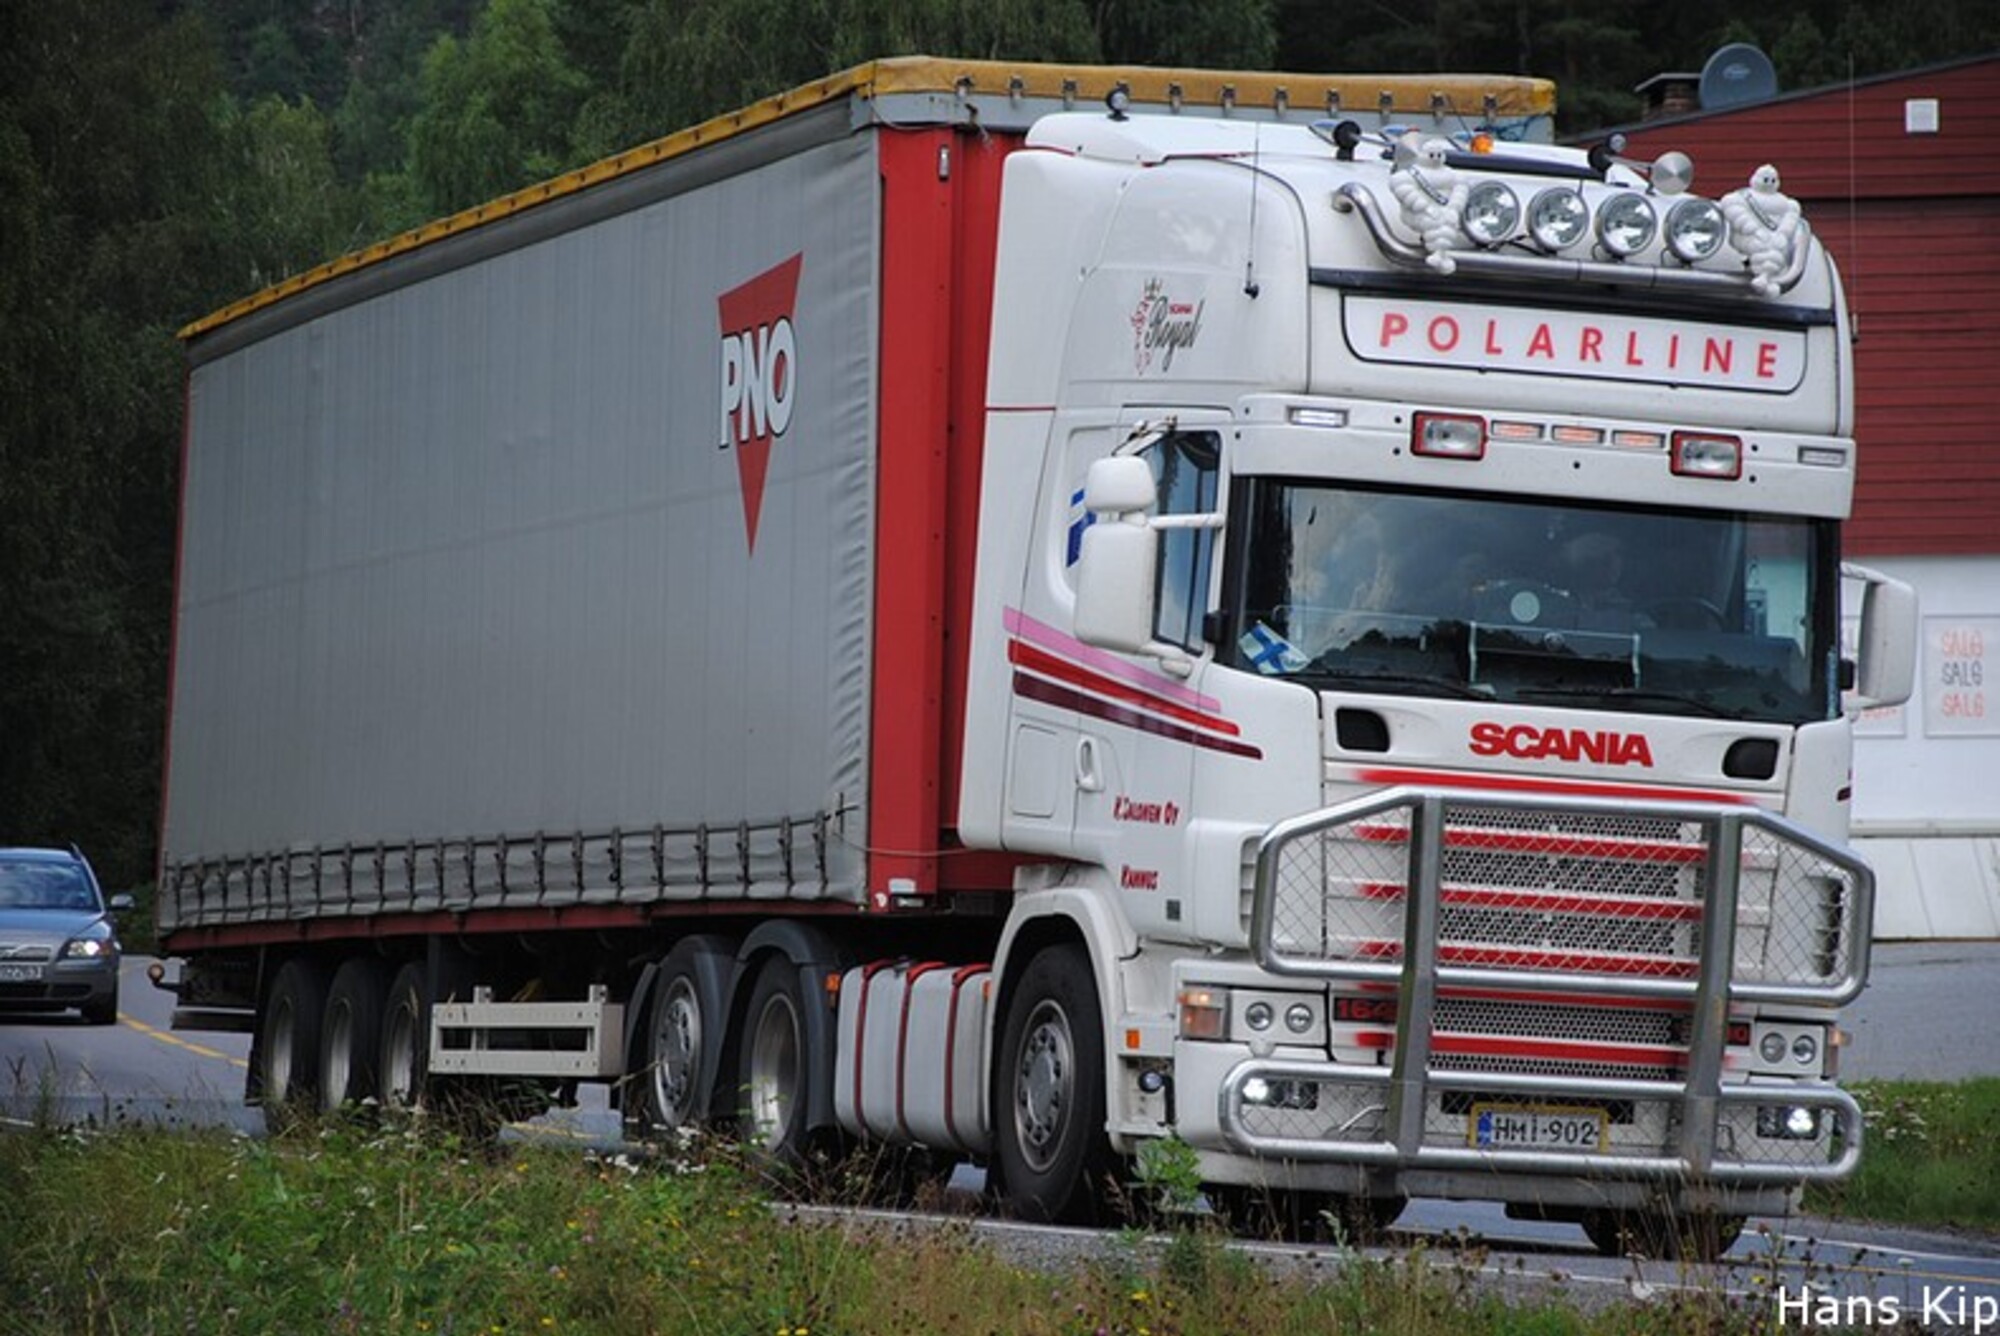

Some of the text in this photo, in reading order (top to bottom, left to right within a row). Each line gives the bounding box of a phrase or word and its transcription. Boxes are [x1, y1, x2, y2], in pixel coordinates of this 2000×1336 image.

[1144, 296, 1205, 372] Royal
[1379, 312, 1779, 378] POLARLINE
[718, 315, 797, 449] PNO
[1468, 722, 1654, 768] SCANIA
